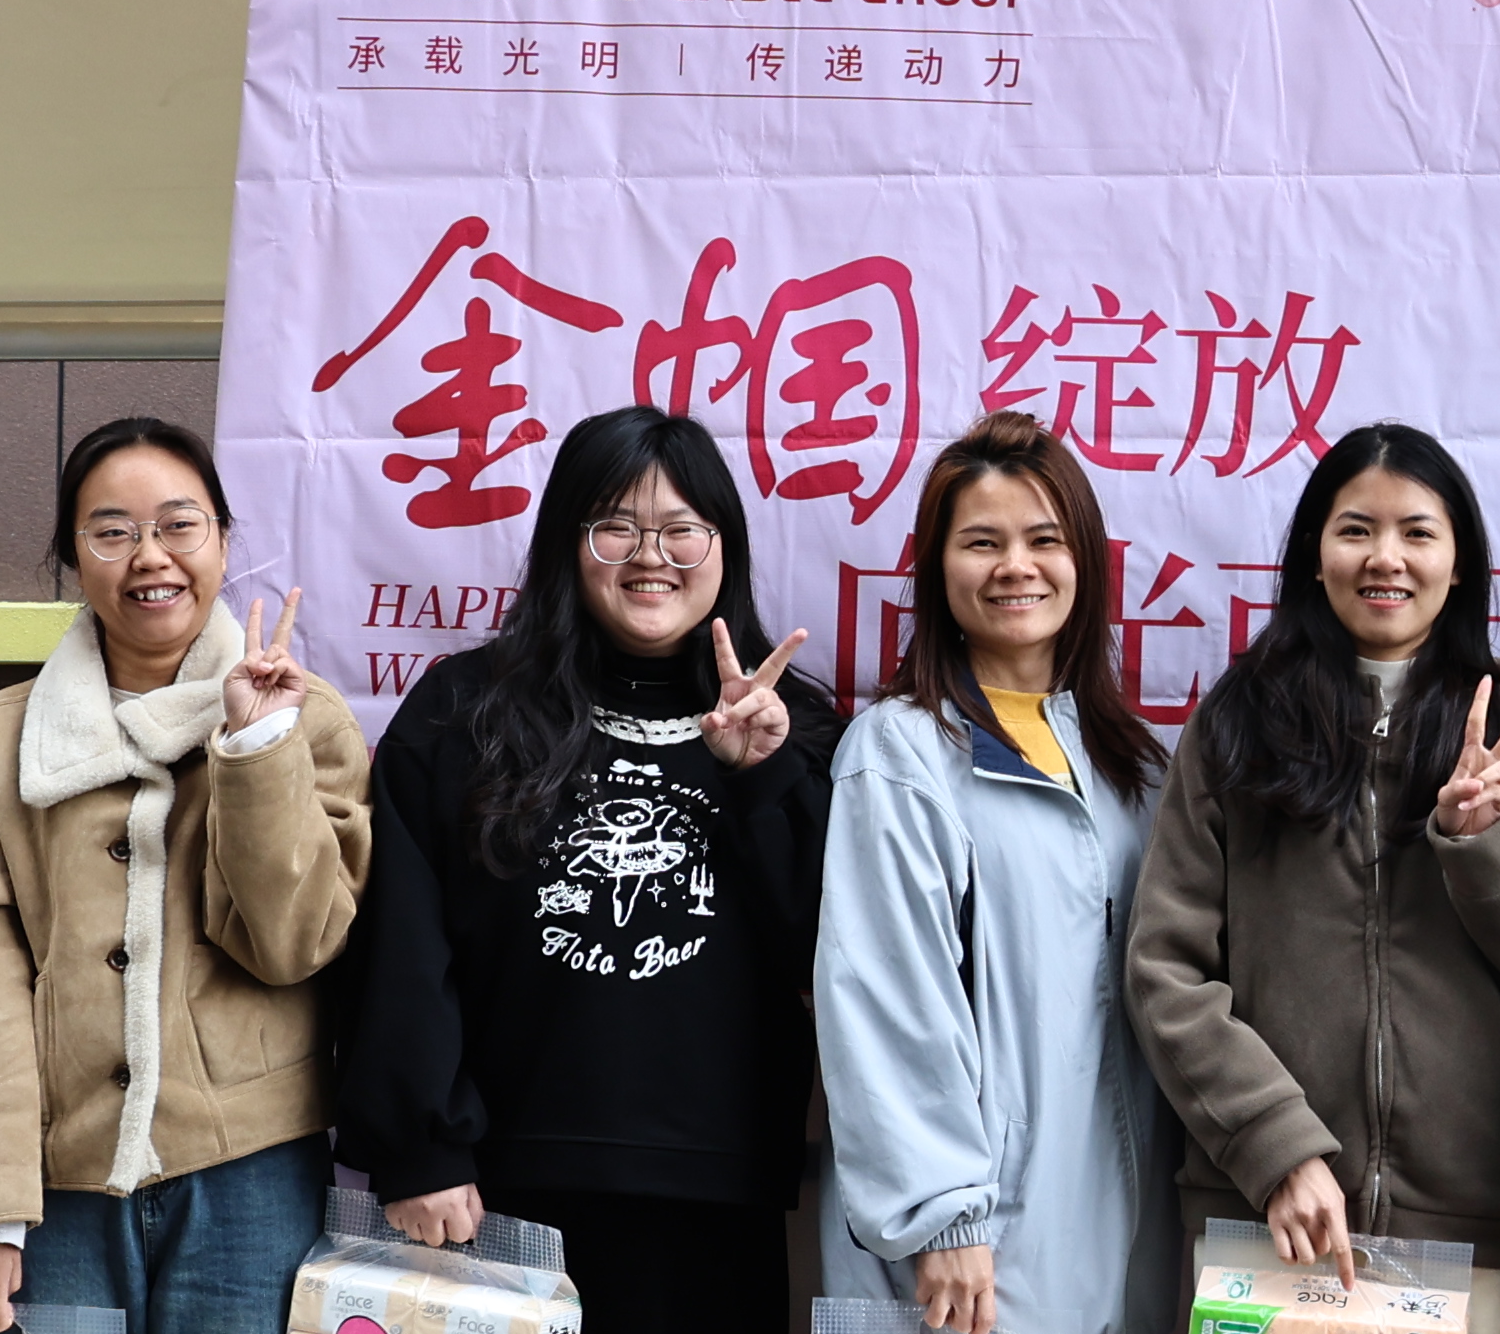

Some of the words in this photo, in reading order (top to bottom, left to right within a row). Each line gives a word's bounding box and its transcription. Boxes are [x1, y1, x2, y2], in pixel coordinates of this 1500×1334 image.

[348, 35, 621, 79] 承载光明
[745, 42, 1022, 89] 传递动力
[629, 935, 706, 980] Baer
[336, 1290, 373, 1310] Face
[1297, 1292, 1348, 1308] Face
[458, 1316, 495, 1334] Face
